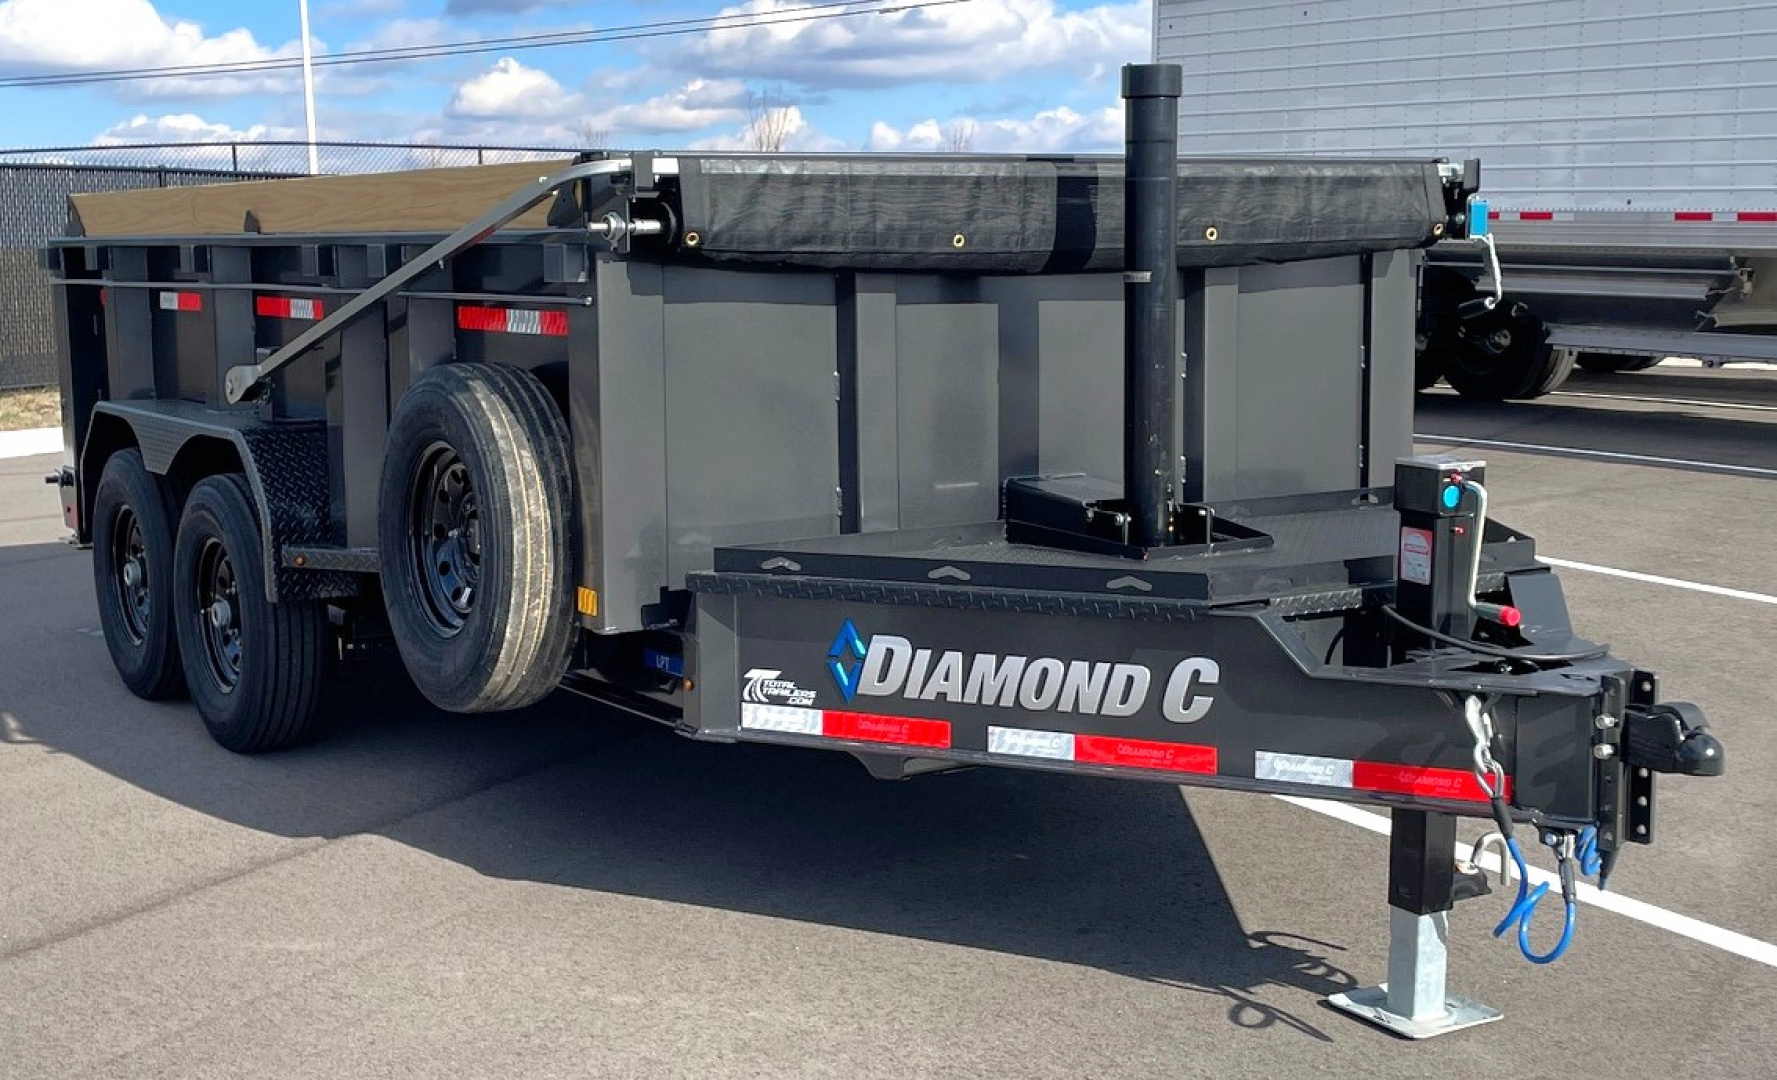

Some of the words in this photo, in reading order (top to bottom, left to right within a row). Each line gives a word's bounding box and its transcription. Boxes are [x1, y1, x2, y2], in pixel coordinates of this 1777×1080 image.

[763, 679, 797, 689] TOTAL
[857, 633, 1151, 718] DIAMOND
[1161, 656, 1220, 725] C
[762, 687, 817, 698] TRAILERS
[1454, 776, 1464, 788] C
